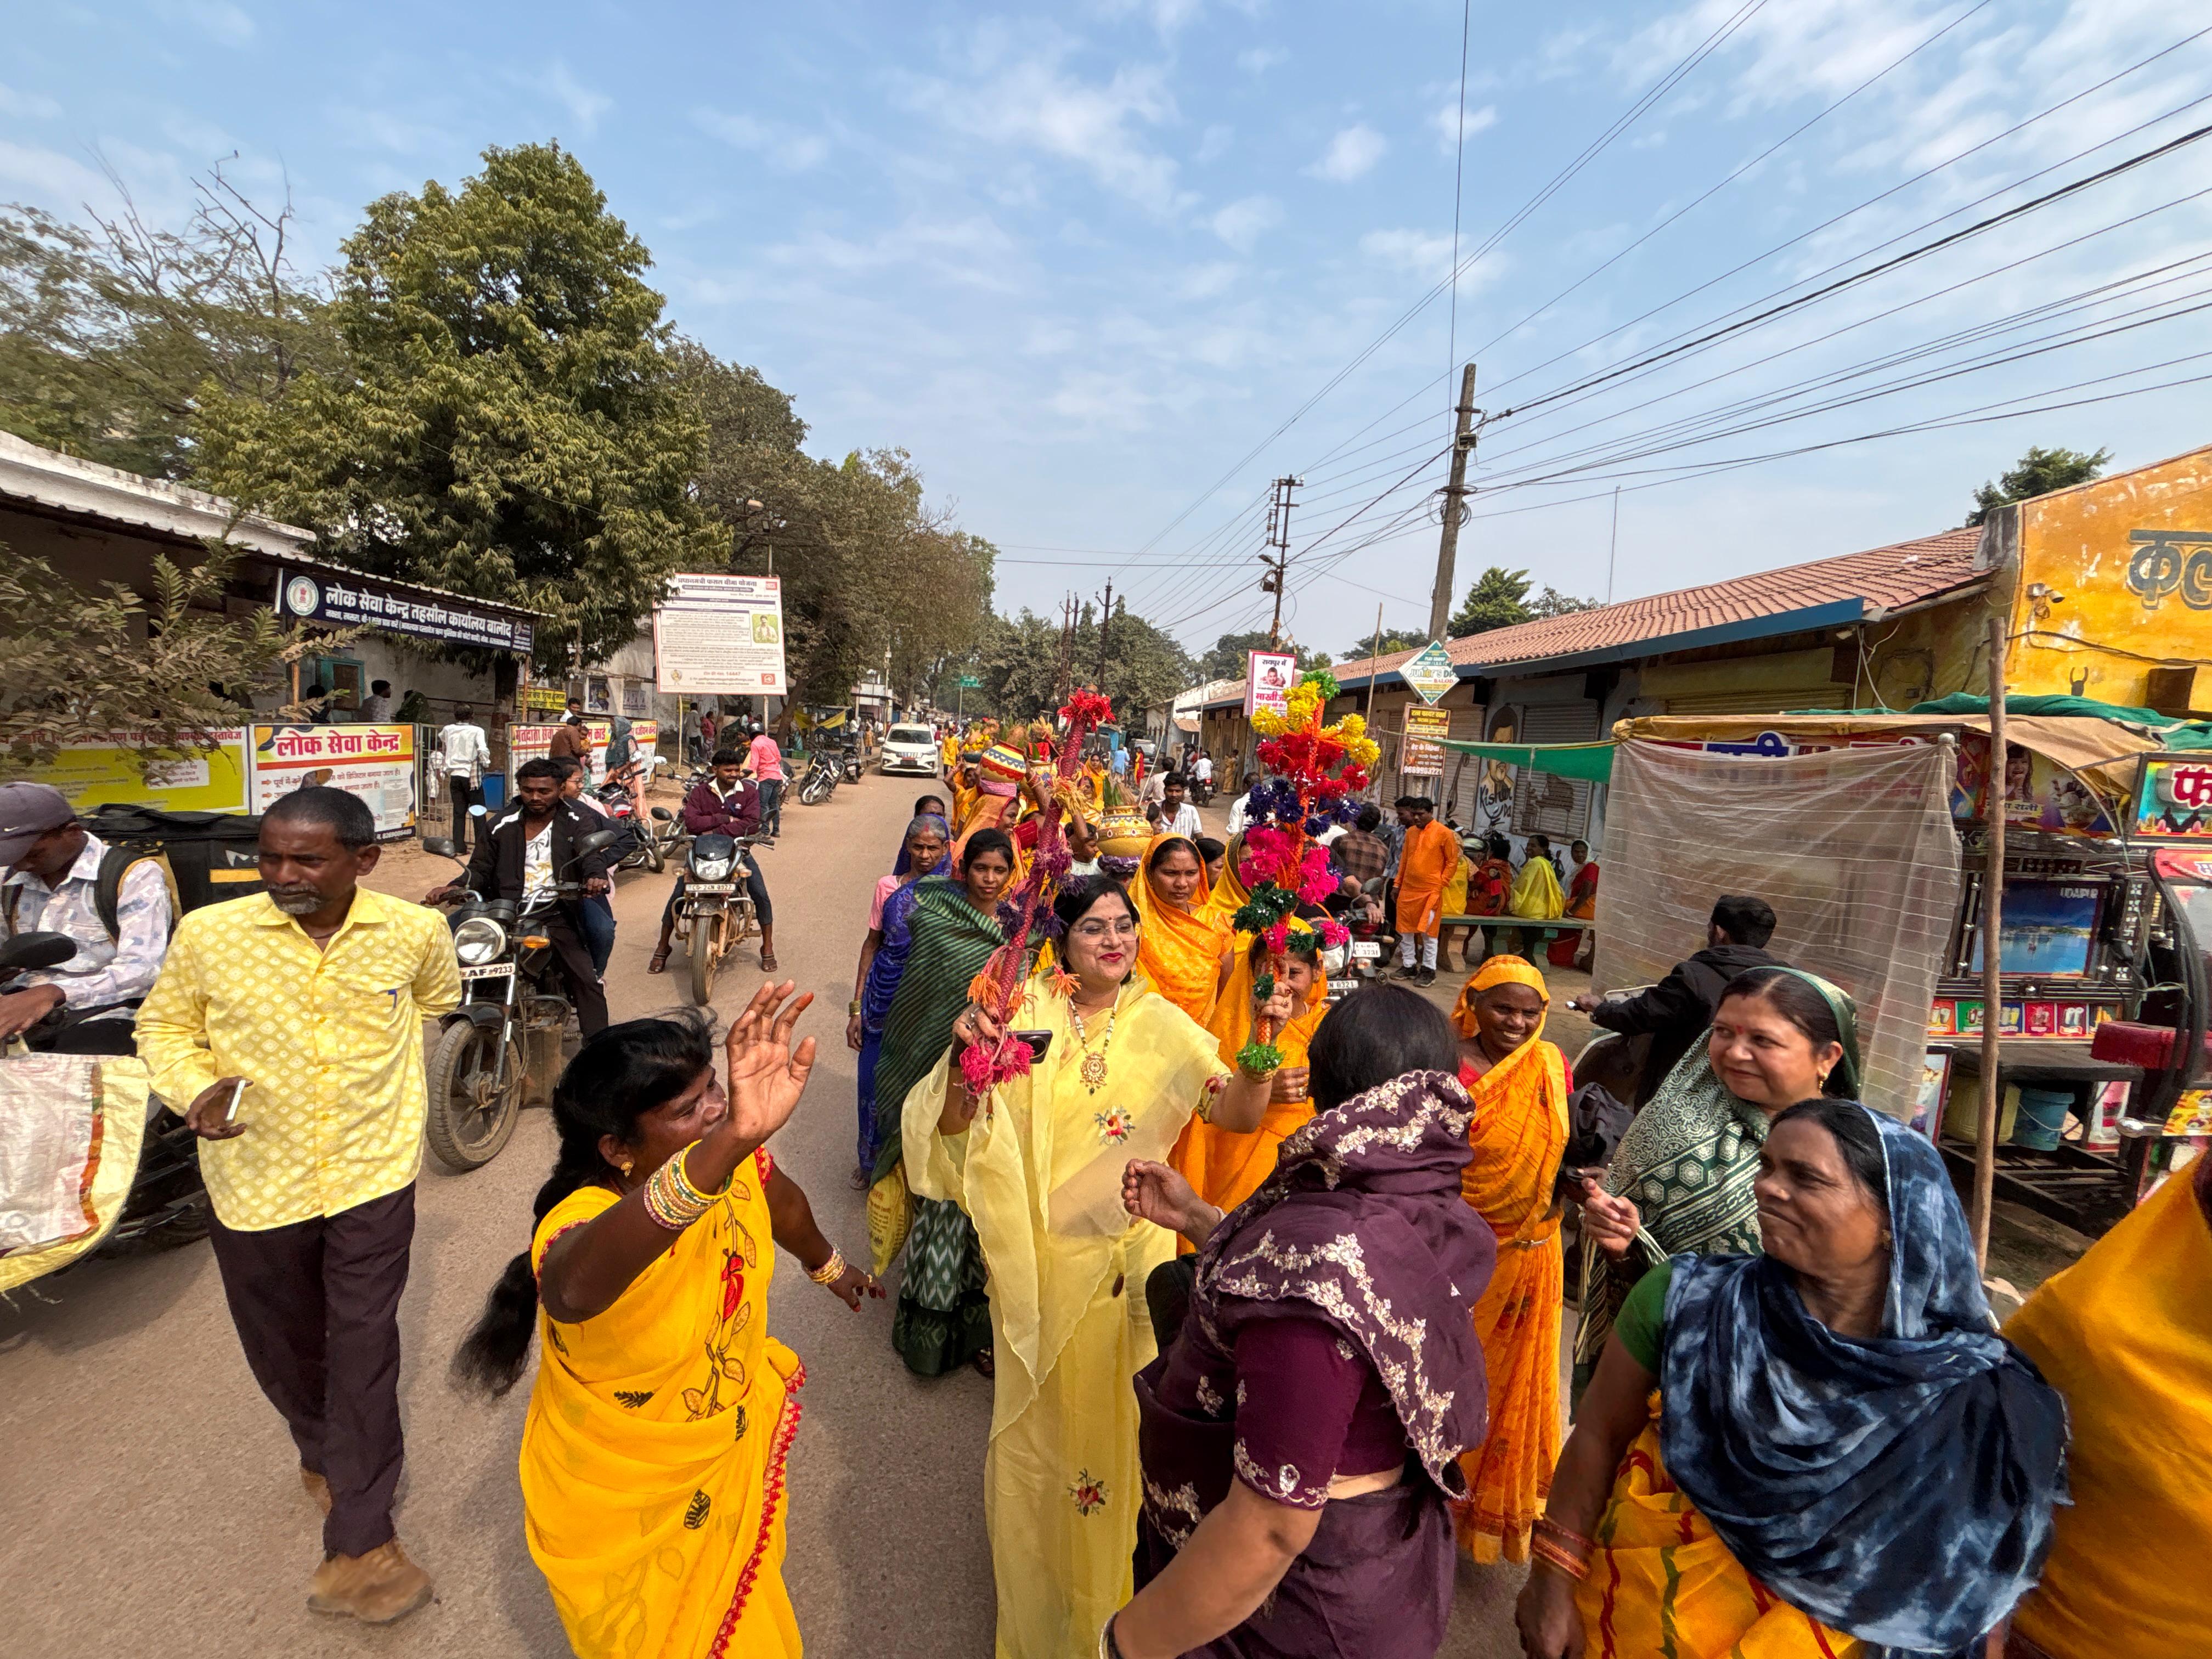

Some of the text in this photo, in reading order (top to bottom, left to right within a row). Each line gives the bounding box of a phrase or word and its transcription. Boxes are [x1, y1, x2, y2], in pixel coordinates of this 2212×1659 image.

[325, 582, 357, 607] लोक
[359, 588, 383, 613] सेवा
[384, 592, 410, 619] केन्द्र
[411, 603, 447, 625] तहसील
[449, 611, 486, 631] कार्यालय
[1255, 691, 1285, 701] माखीज
[594, 725, 606, 740] कार्ड
[276, 729, 399, 756] लोक सेवा केन्द्र
[346, 771, 366, 780] डिजिटल
[494, 966, 512, 974] 9233
